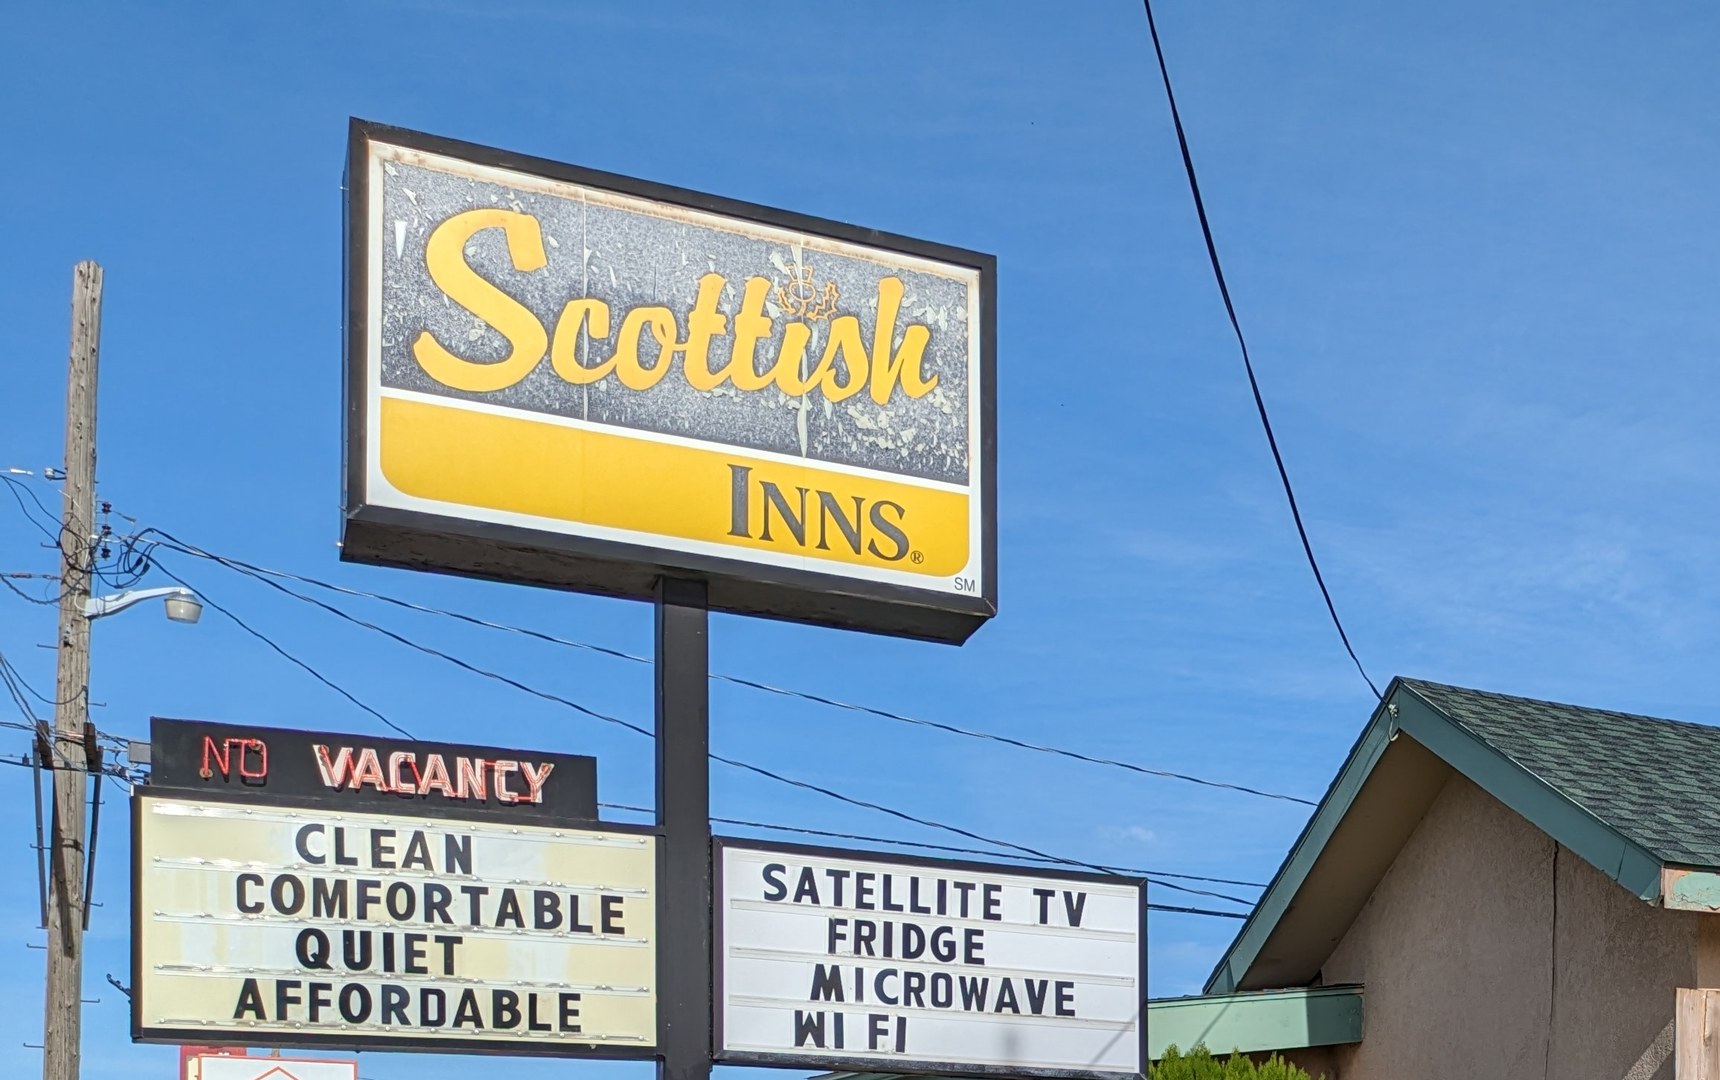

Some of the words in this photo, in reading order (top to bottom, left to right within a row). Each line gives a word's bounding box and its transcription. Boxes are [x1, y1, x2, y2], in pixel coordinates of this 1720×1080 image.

[412, 207, 939, 406] Scottish
[954, 576, 976, 593] SM
[201, 735, 268, 780] NO
[313, 744, 555, 803] VACANCY
[295, 823, 473, 875] CLEAN
[235, 873, 625, 935] COMFORTABLE
[761, 863, 1002, 921] SATELLITE
[1032, 888, 1087, 927] TV
[295, 928, 464, 976] QUIET
[828, 917, 985, 965] FRIDGE
[233, 978, 583, 1033] AFFORDABLE
[809, 964, 1076, 1017] MICROWAVE
